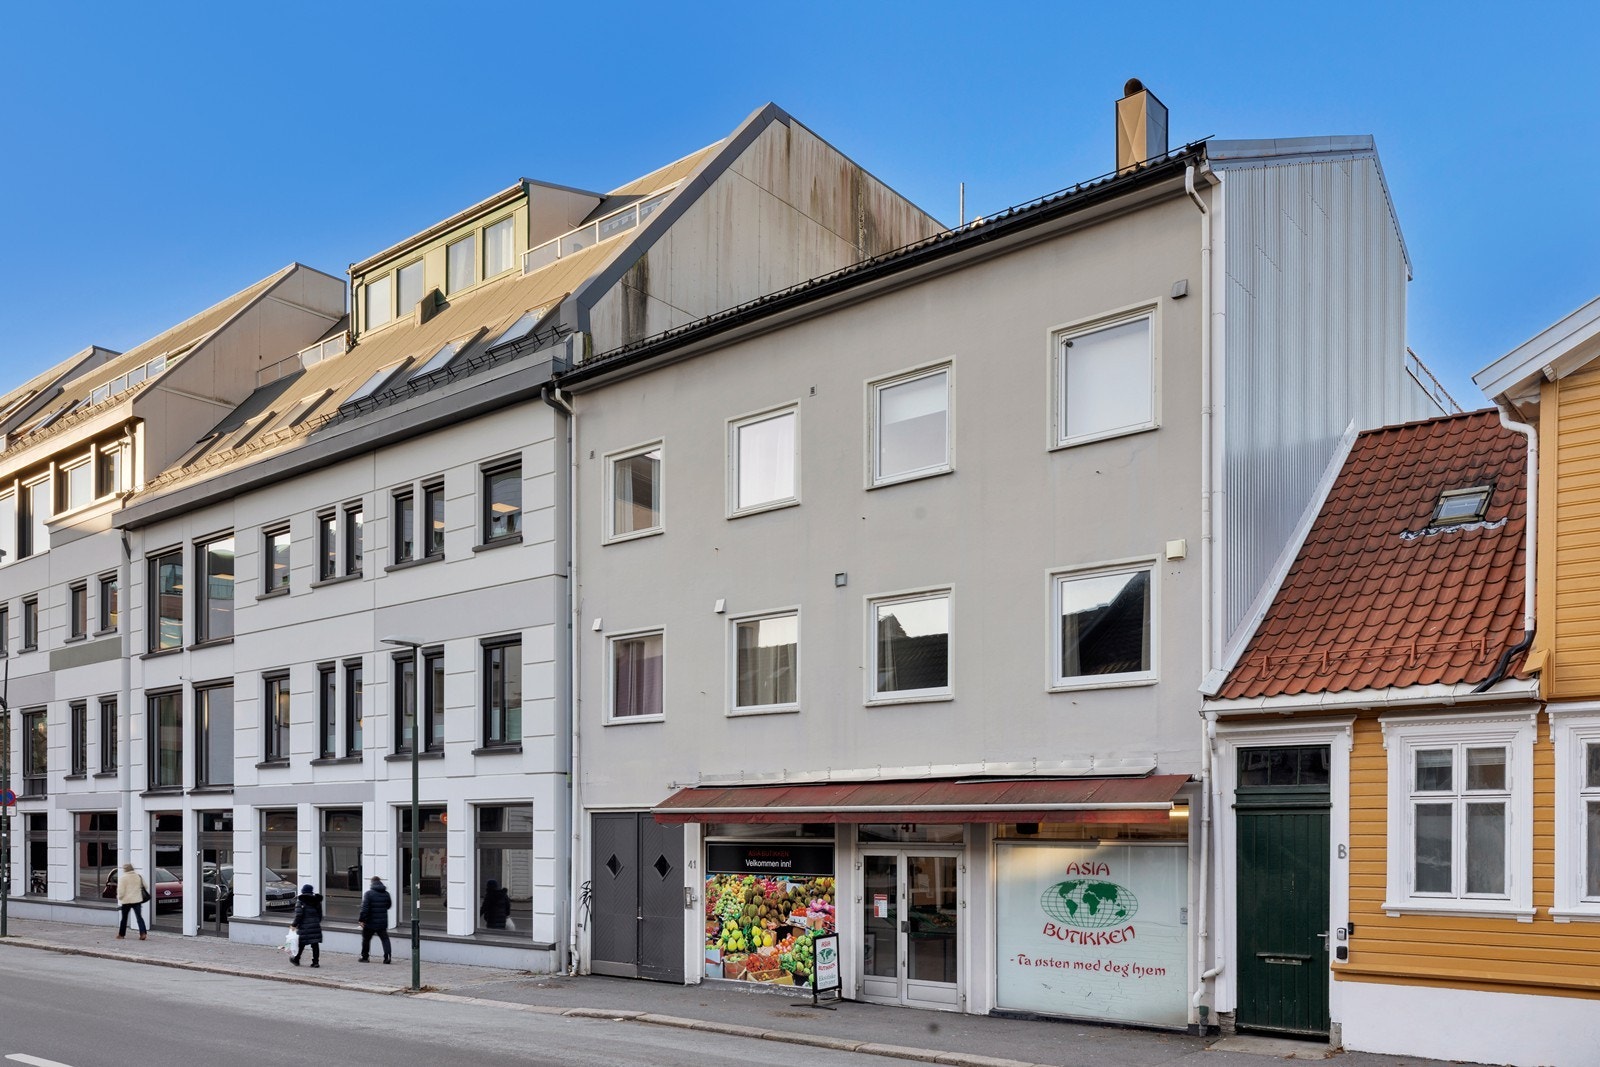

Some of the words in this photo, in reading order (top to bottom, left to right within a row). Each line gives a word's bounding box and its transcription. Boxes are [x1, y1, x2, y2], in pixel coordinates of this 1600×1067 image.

[688, 860, 697, 869] 41
[745, 859, 779, 868] Velkommen
[780, 860, 792, 868] inn!
[1066, 861, 1110, 876] ASIA
[1042, 922, 1136, 946] BUTIKKEN
[1017, 953, 1032, 966] Ta
[1034, 956, 1070, 969] østen
[1073, 959, 1101, 972] med
[1104, 960, 1129, 977] deg
[1132, 962, 1166, 979] hjem
